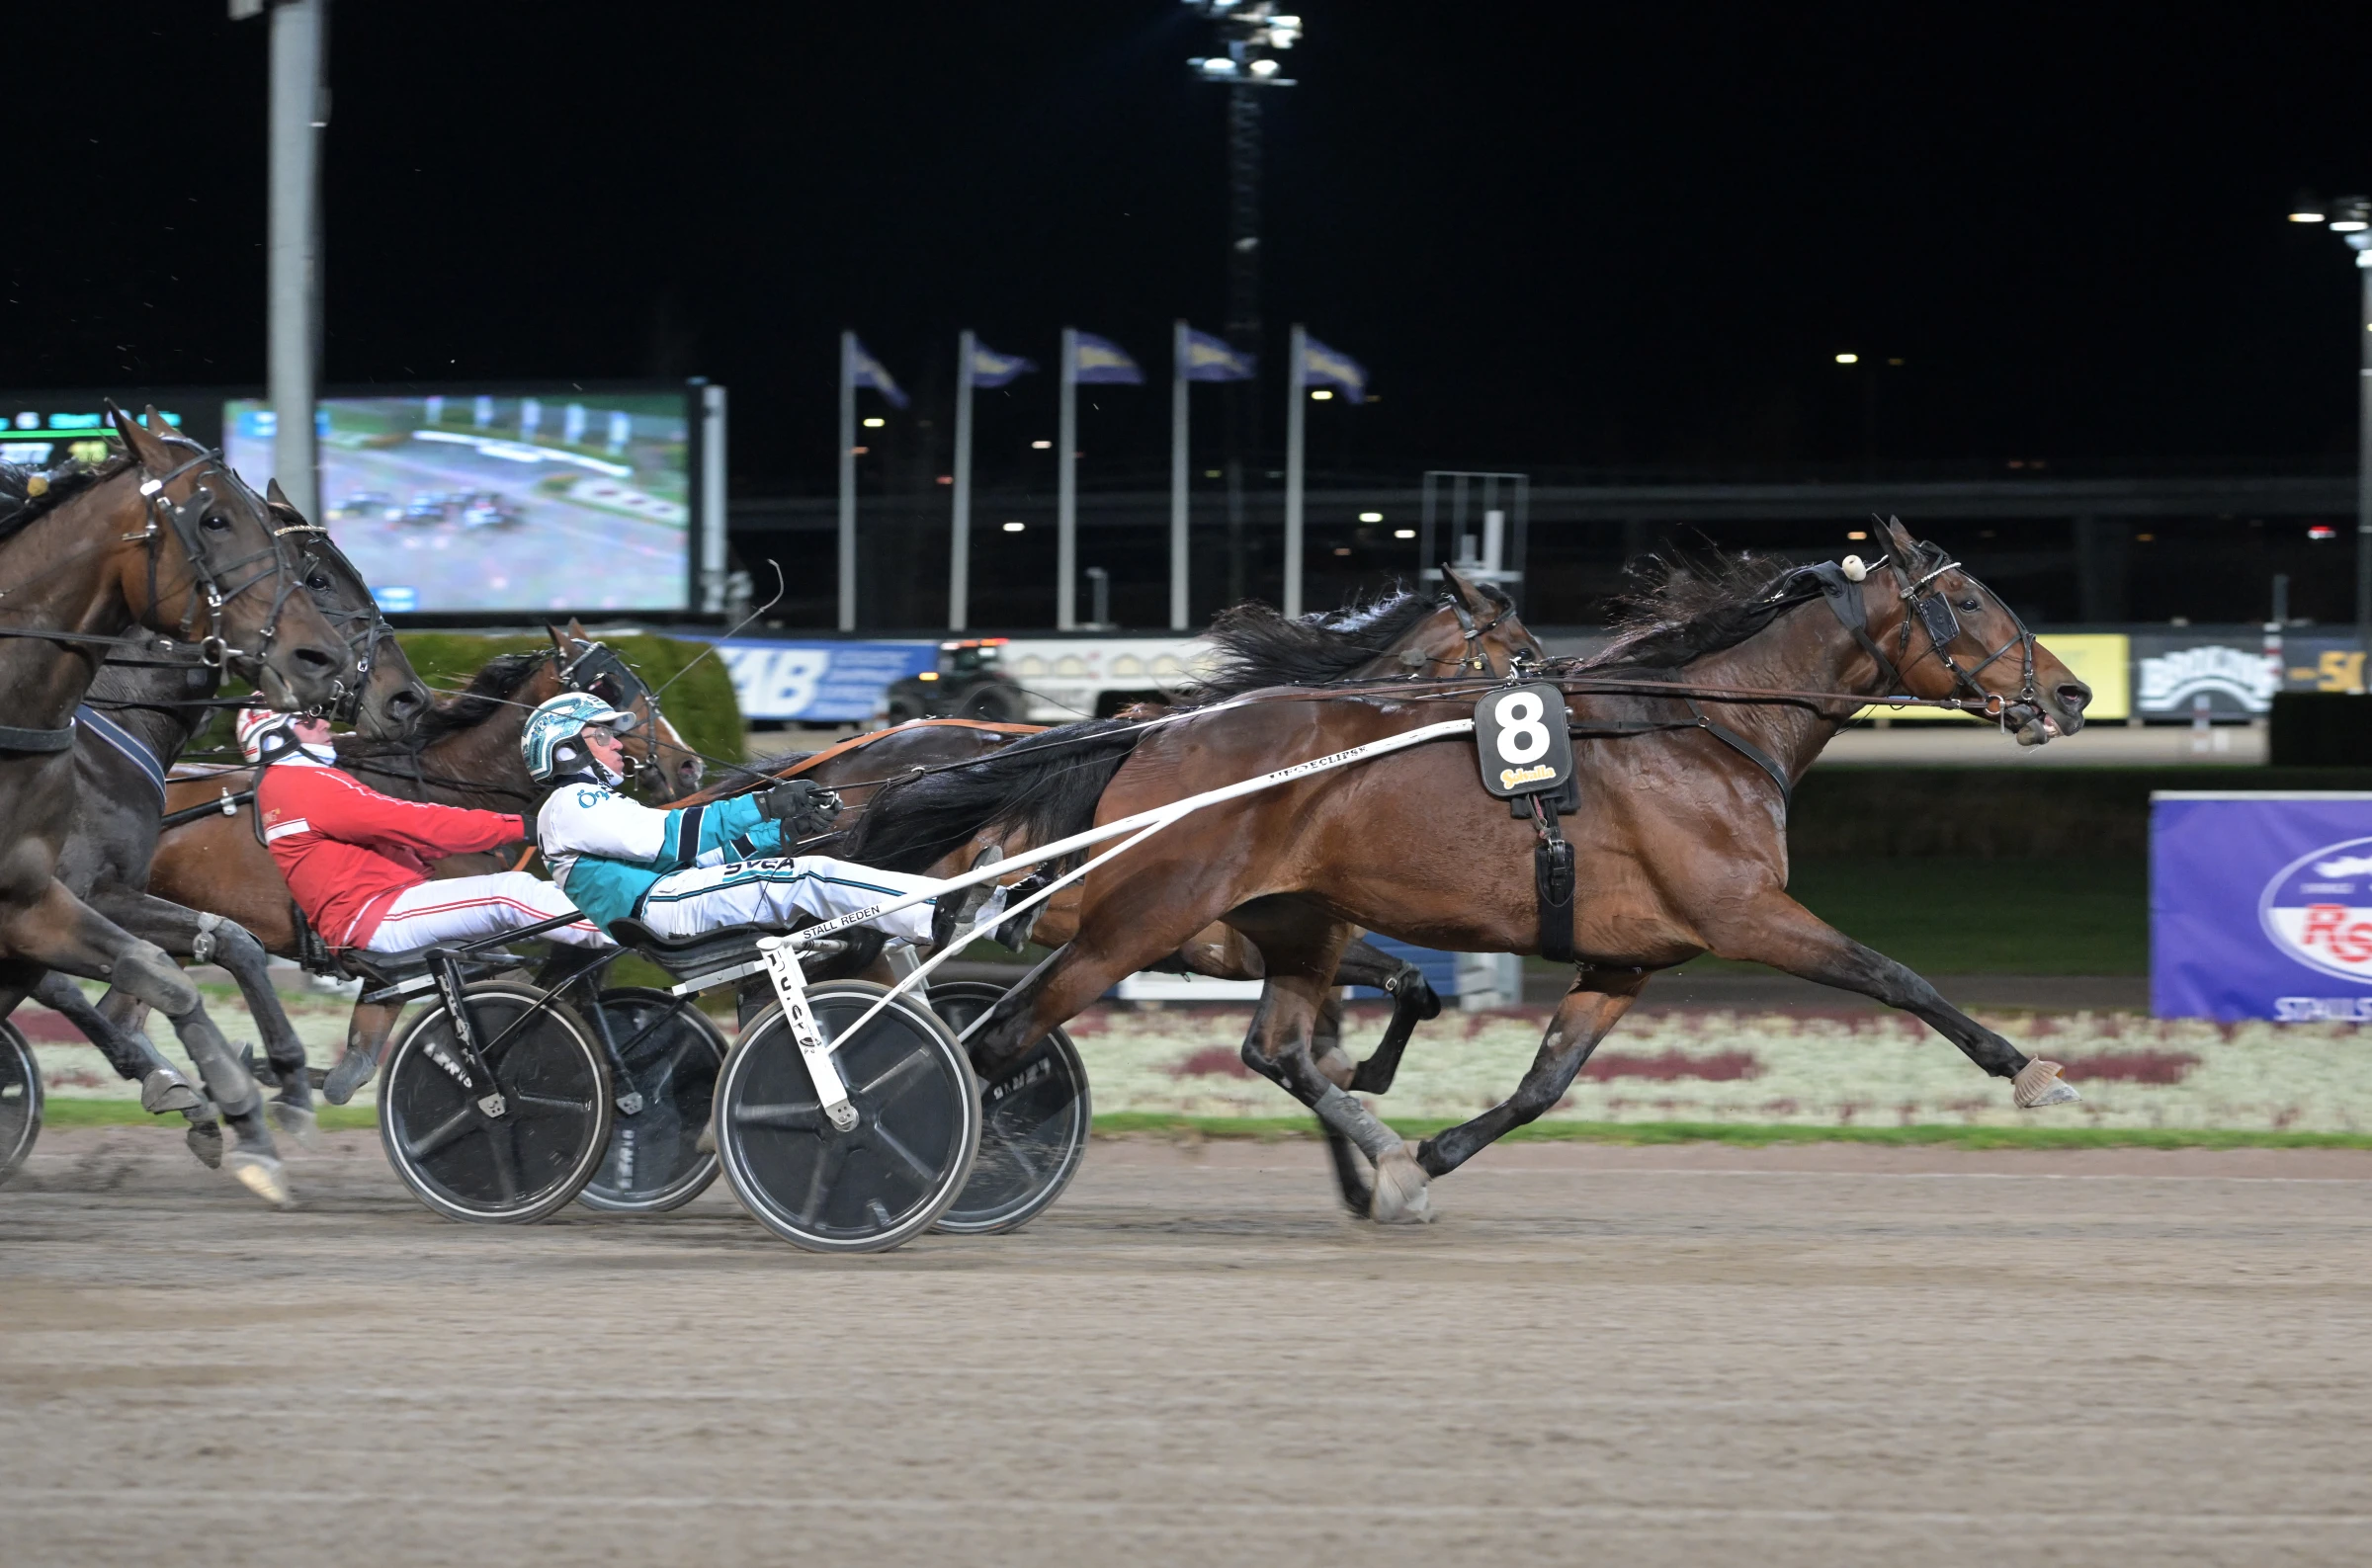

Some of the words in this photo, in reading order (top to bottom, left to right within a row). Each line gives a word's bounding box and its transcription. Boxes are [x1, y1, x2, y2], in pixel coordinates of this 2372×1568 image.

[1494, 692, 1551, 764] 8
[1499, 764, 1557, 789] Solvalla
[803, 922, 838, 940] STALL
[840, 904, 881, 926] REDEN
